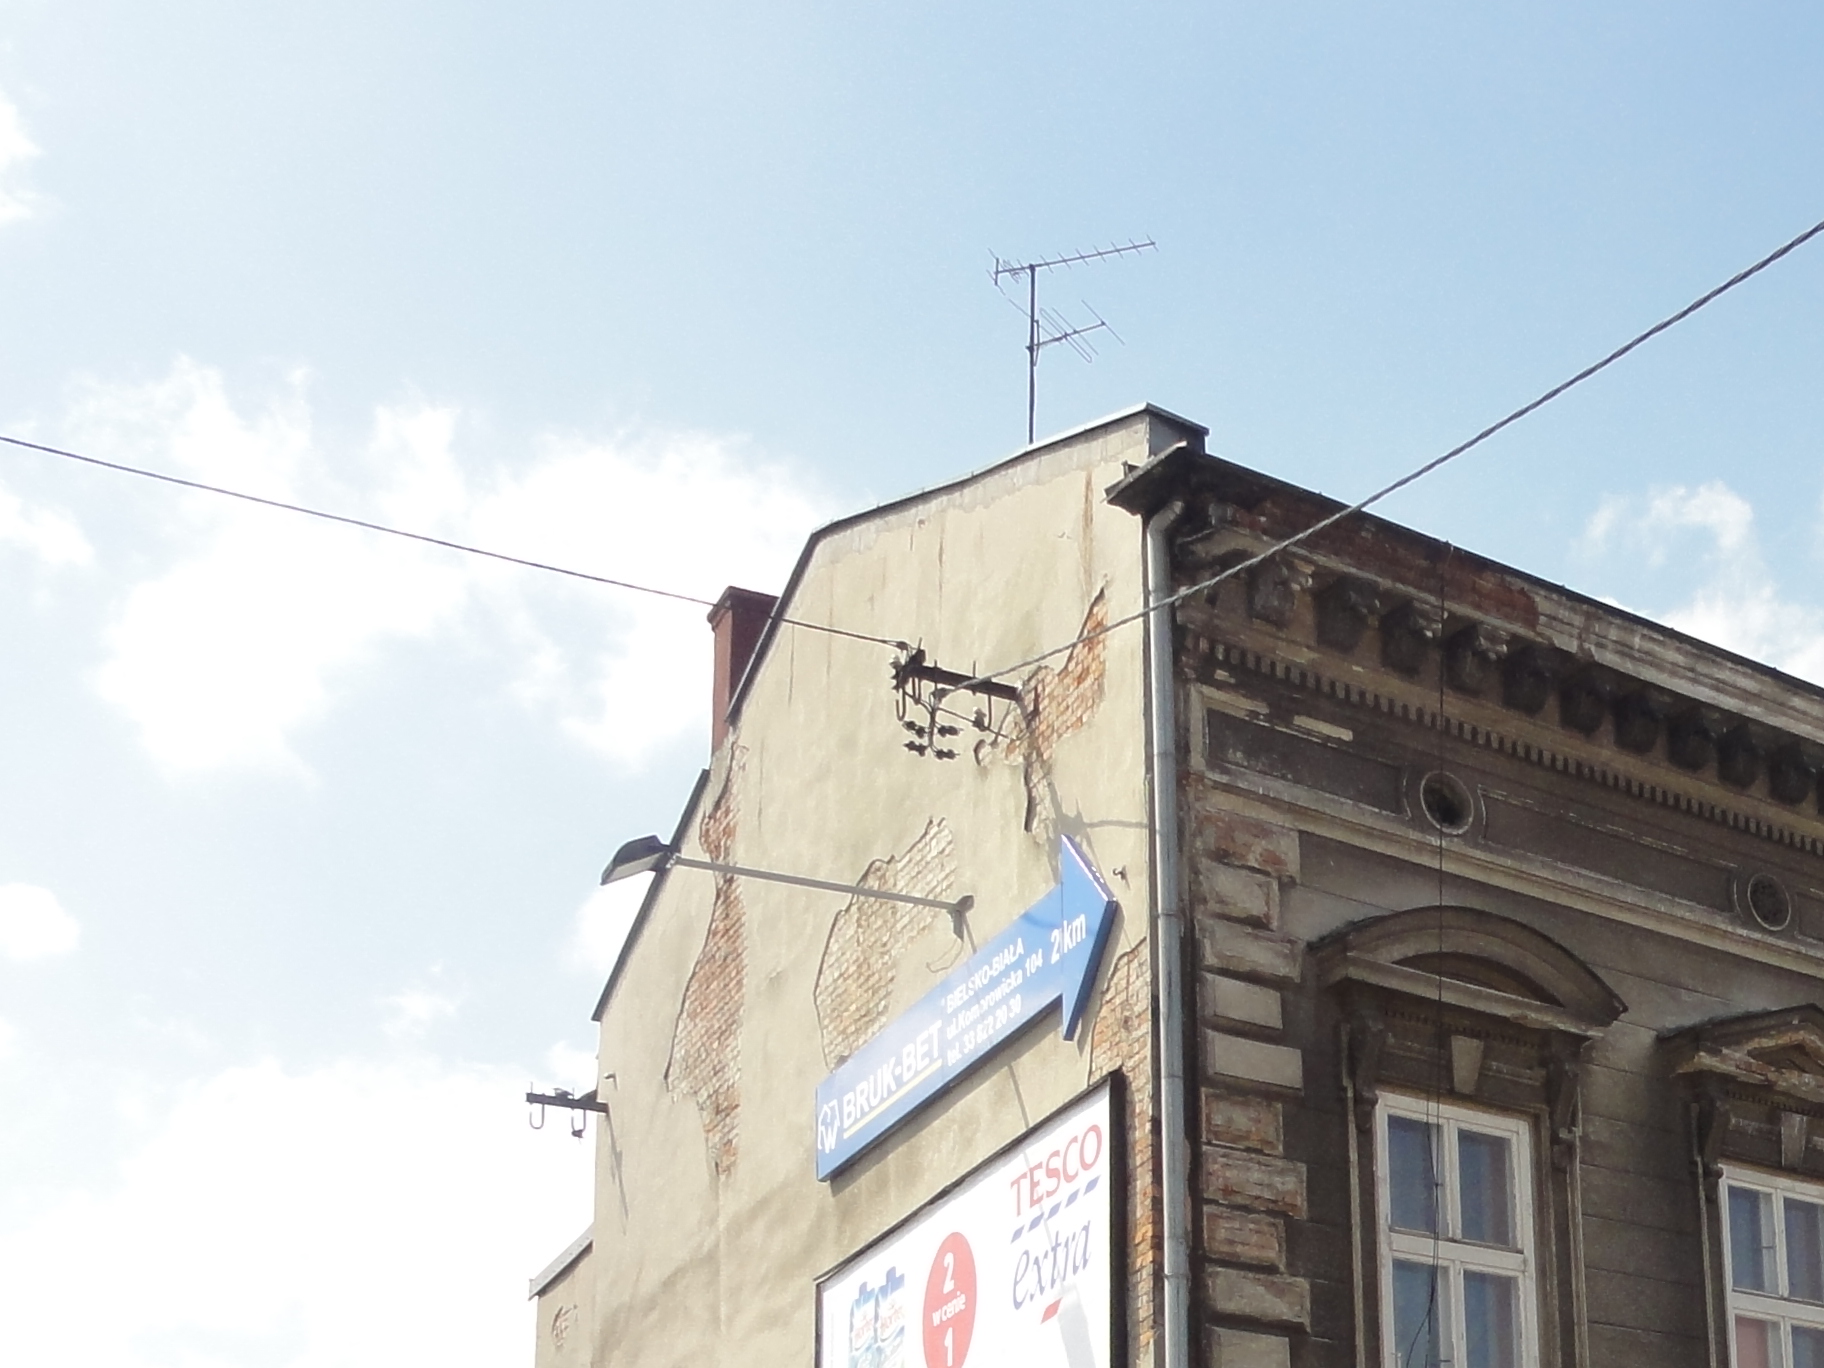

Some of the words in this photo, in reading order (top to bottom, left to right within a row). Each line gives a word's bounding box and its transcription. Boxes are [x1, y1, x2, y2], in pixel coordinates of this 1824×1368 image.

[1025, 948, 1043, 977] 104
[1051, 928, 1062, 964] 2
[1063, 913, 1087, 954] km
[946, 937, 1024, 1014] BIELSKO-BIAŁA
[963, 1030, 976, 1054] 33
[976, 1015, 994, 1044] 822
[995, 1004, 1008, 1030] 20
[1009, 993, 1022, 1018] 30
[843, 1019, 943, 1129] BRUK-BET
[1010, 1124, 1103, 1217] TESCO
[943, 1252, 955, 1294] 2
[1012, 1217, 1092, 1311] extra
[932, 1309, 941, 1327] w
[941, 1291, 966, 1322] cenie
[944, 1327, 953, 1367] 1
